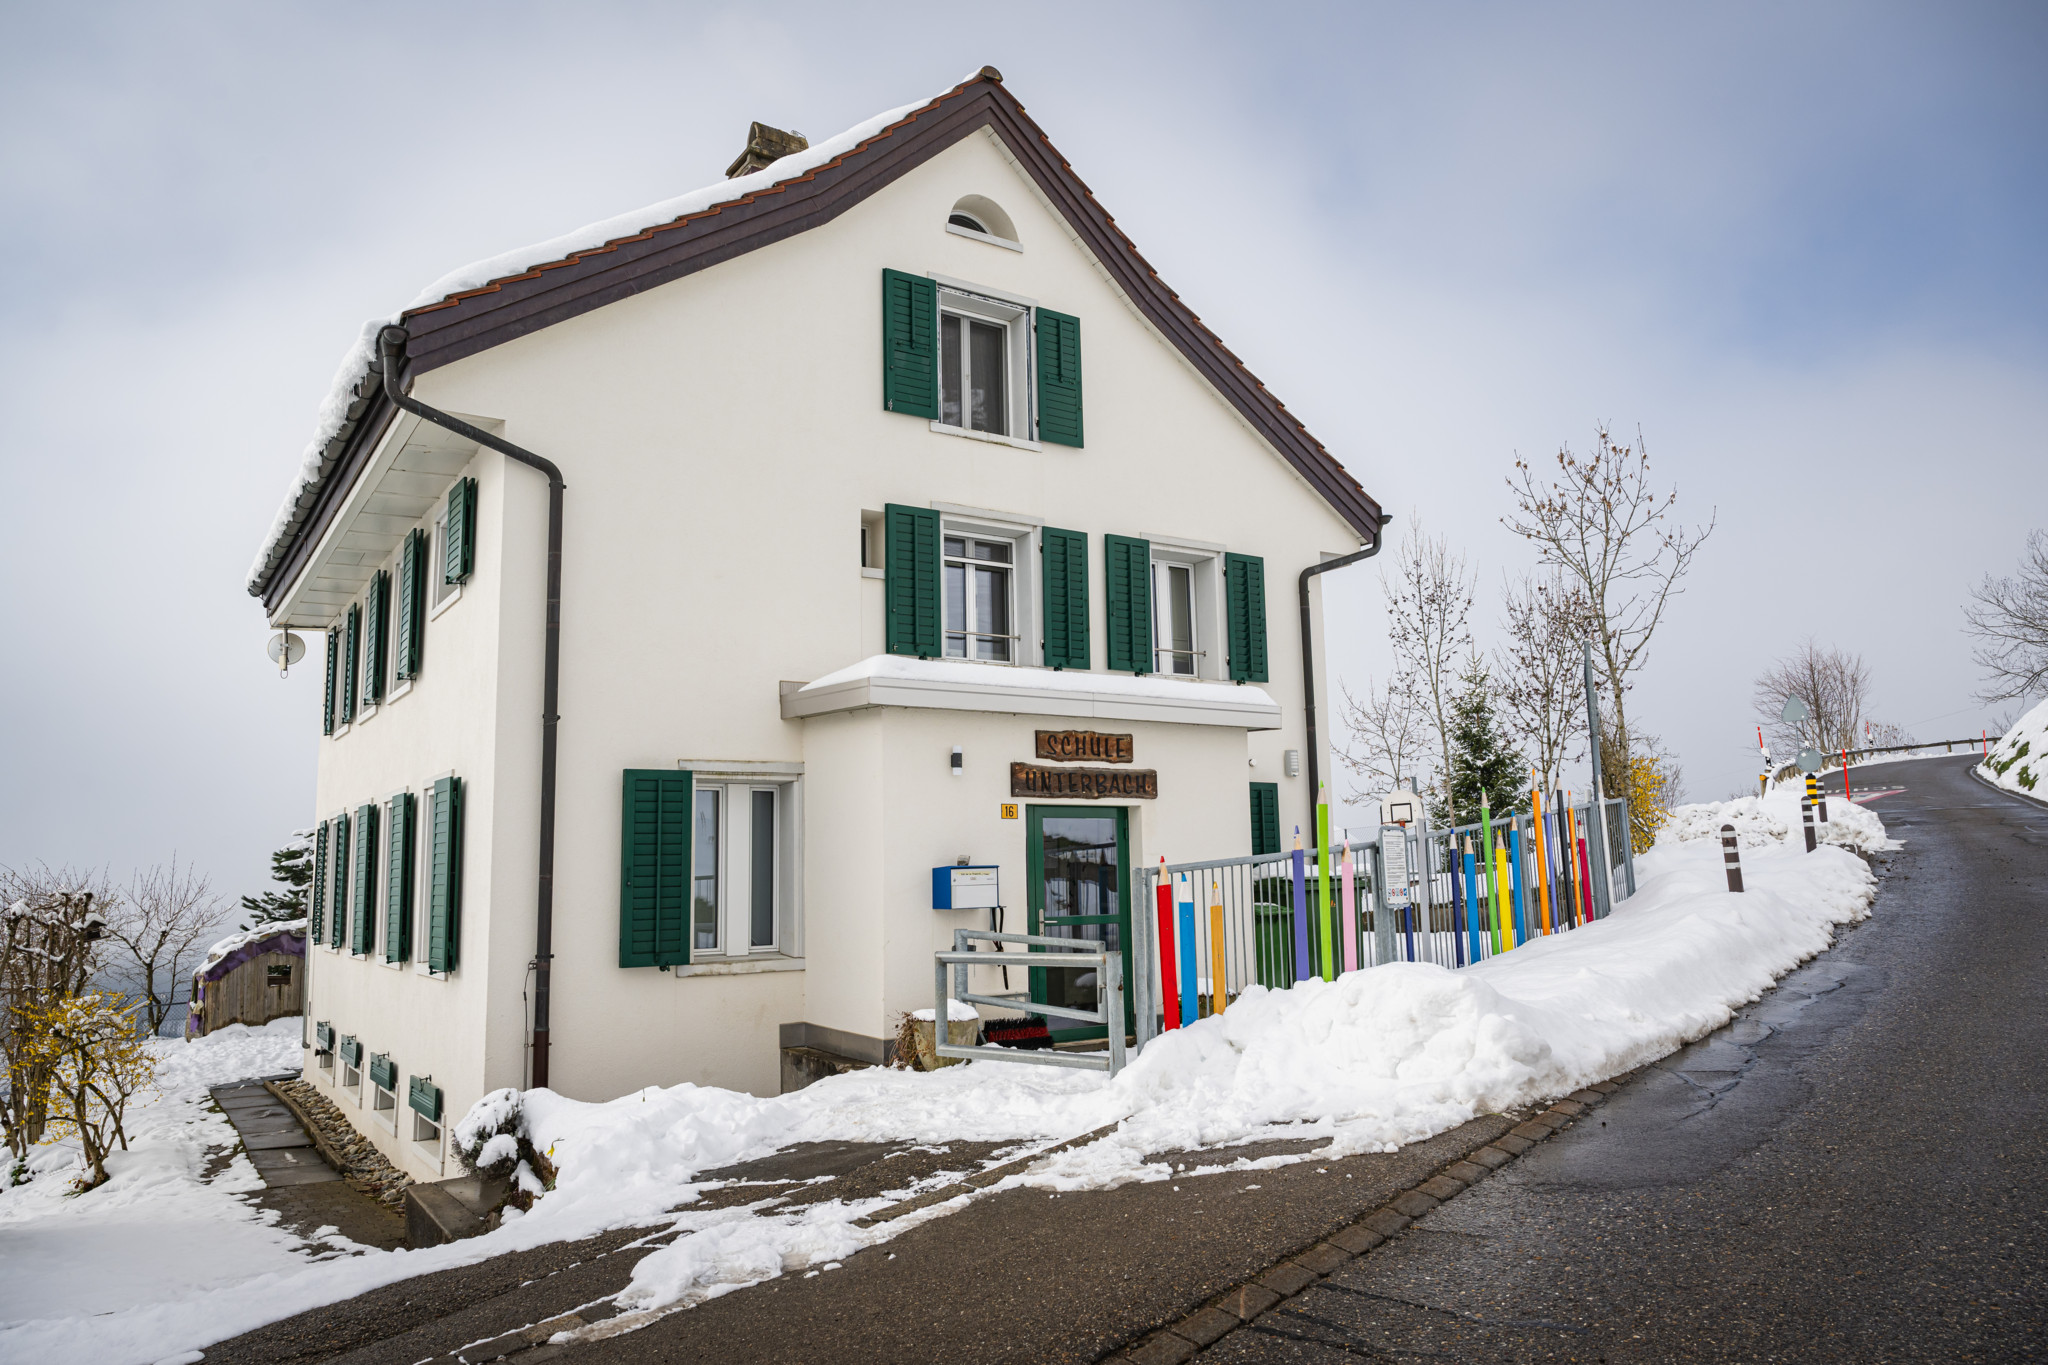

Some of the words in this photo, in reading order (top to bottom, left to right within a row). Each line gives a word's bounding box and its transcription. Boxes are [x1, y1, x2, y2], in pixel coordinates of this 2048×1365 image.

[1047, 734, 1126, 758] SCHULE
[1025, 770, 1148, 794] UNTERBACH
[1004, 806, 1014, 817] 16
